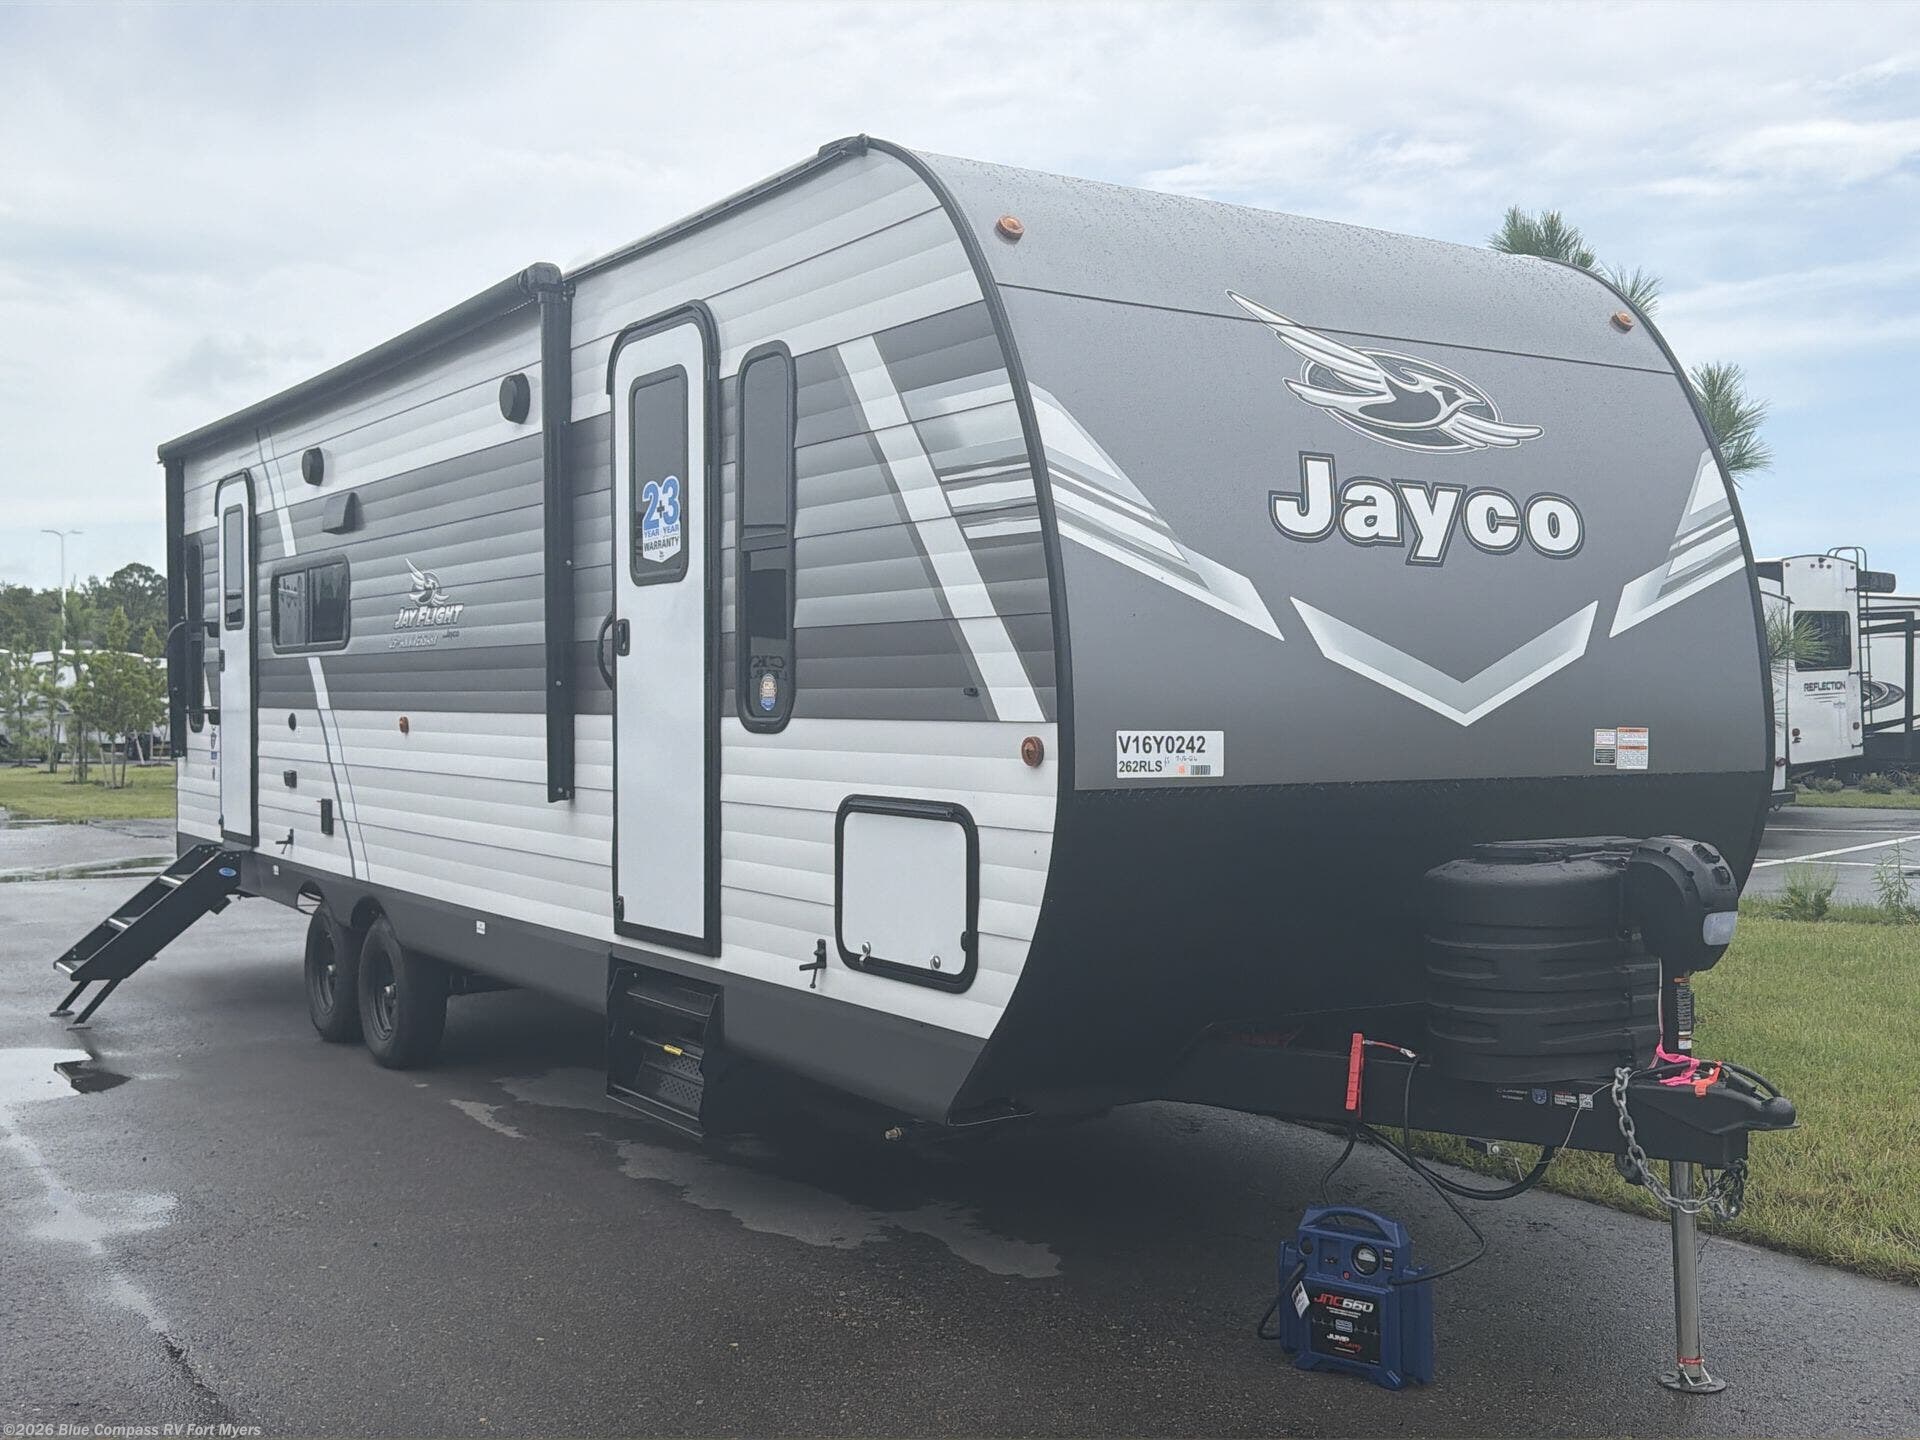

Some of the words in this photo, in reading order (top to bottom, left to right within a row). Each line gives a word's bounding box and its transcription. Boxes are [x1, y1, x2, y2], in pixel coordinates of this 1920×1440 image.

[1270, 452, 1584, 566] Jayco
[644, 528, 660, 538] YEAR
[663, 524, 680, 534] YEAR
[644, 536, 680, 552] WARRANTY
[394, 607, 418, 629] JAY
[416, 603, 464, 627] FLIGHT
[1804, 681, 1846, 692] REFLECTION
[1118, 736, 1206, 754] V16Y0242
[1119, 760, 1163, 773] 262RLS
